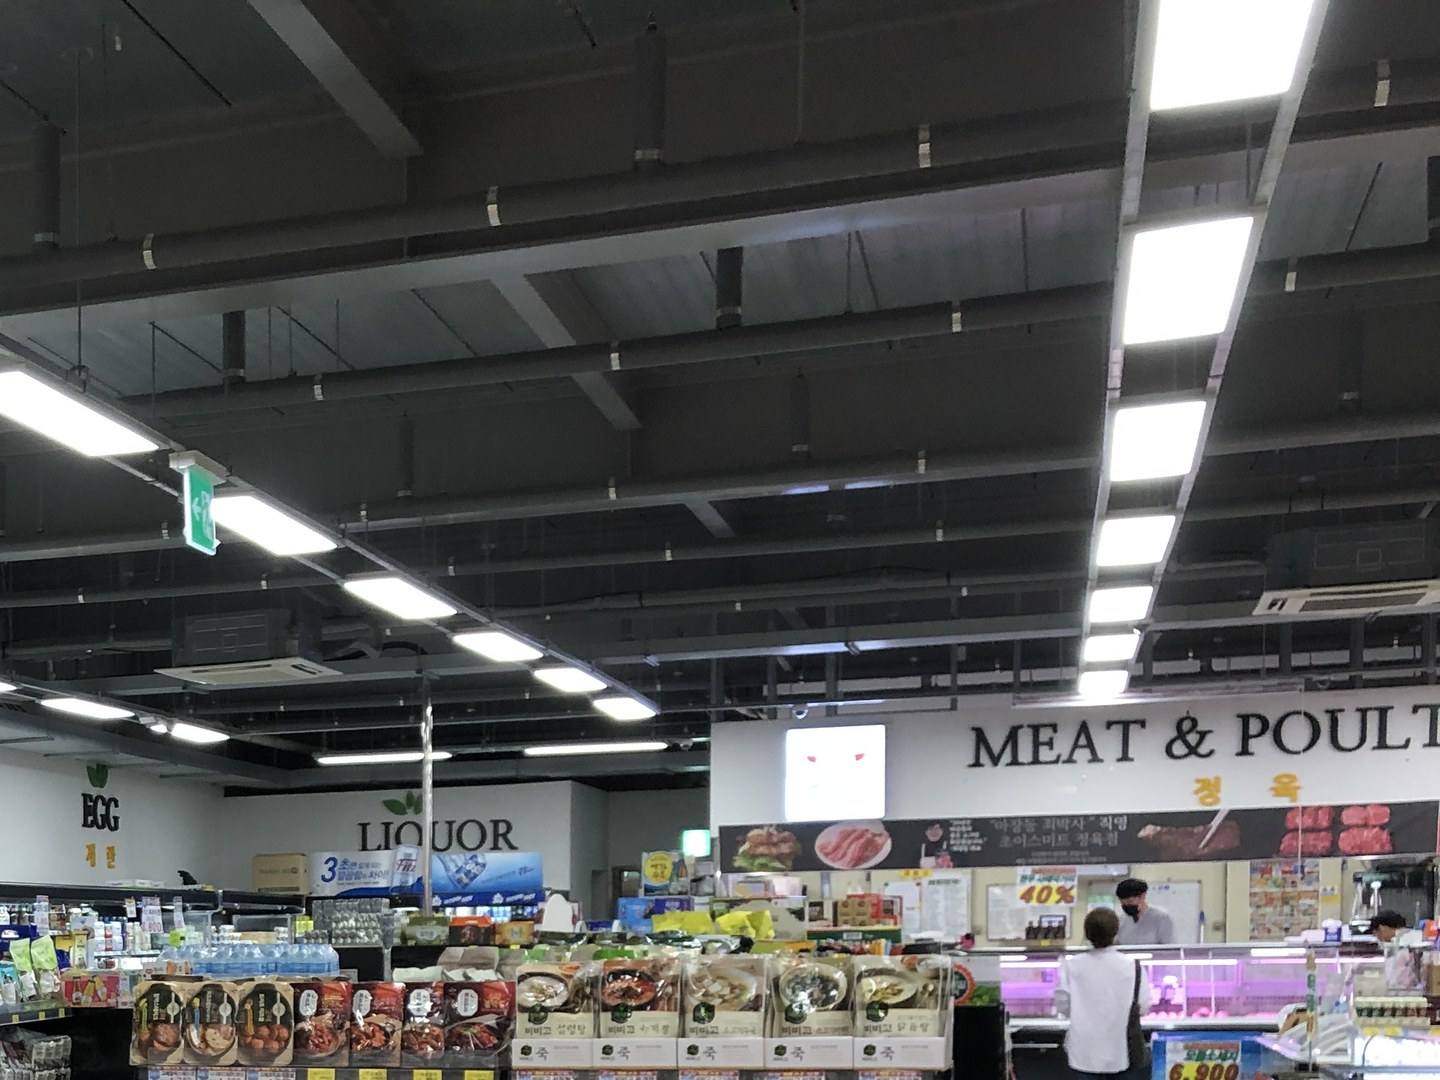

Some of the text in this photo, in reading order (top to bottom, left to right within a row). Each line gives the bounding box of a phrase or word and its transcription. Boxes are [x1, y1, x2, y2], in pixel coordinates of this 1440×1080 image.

[968, 718, 1146, 768] MEAT
[1165, 710, 1215, 760] &
[81, 793, 120, 832] EGG
[357, 818, 519, 852] LIQUOR
[1019, 884, 1076, 904] 40%
